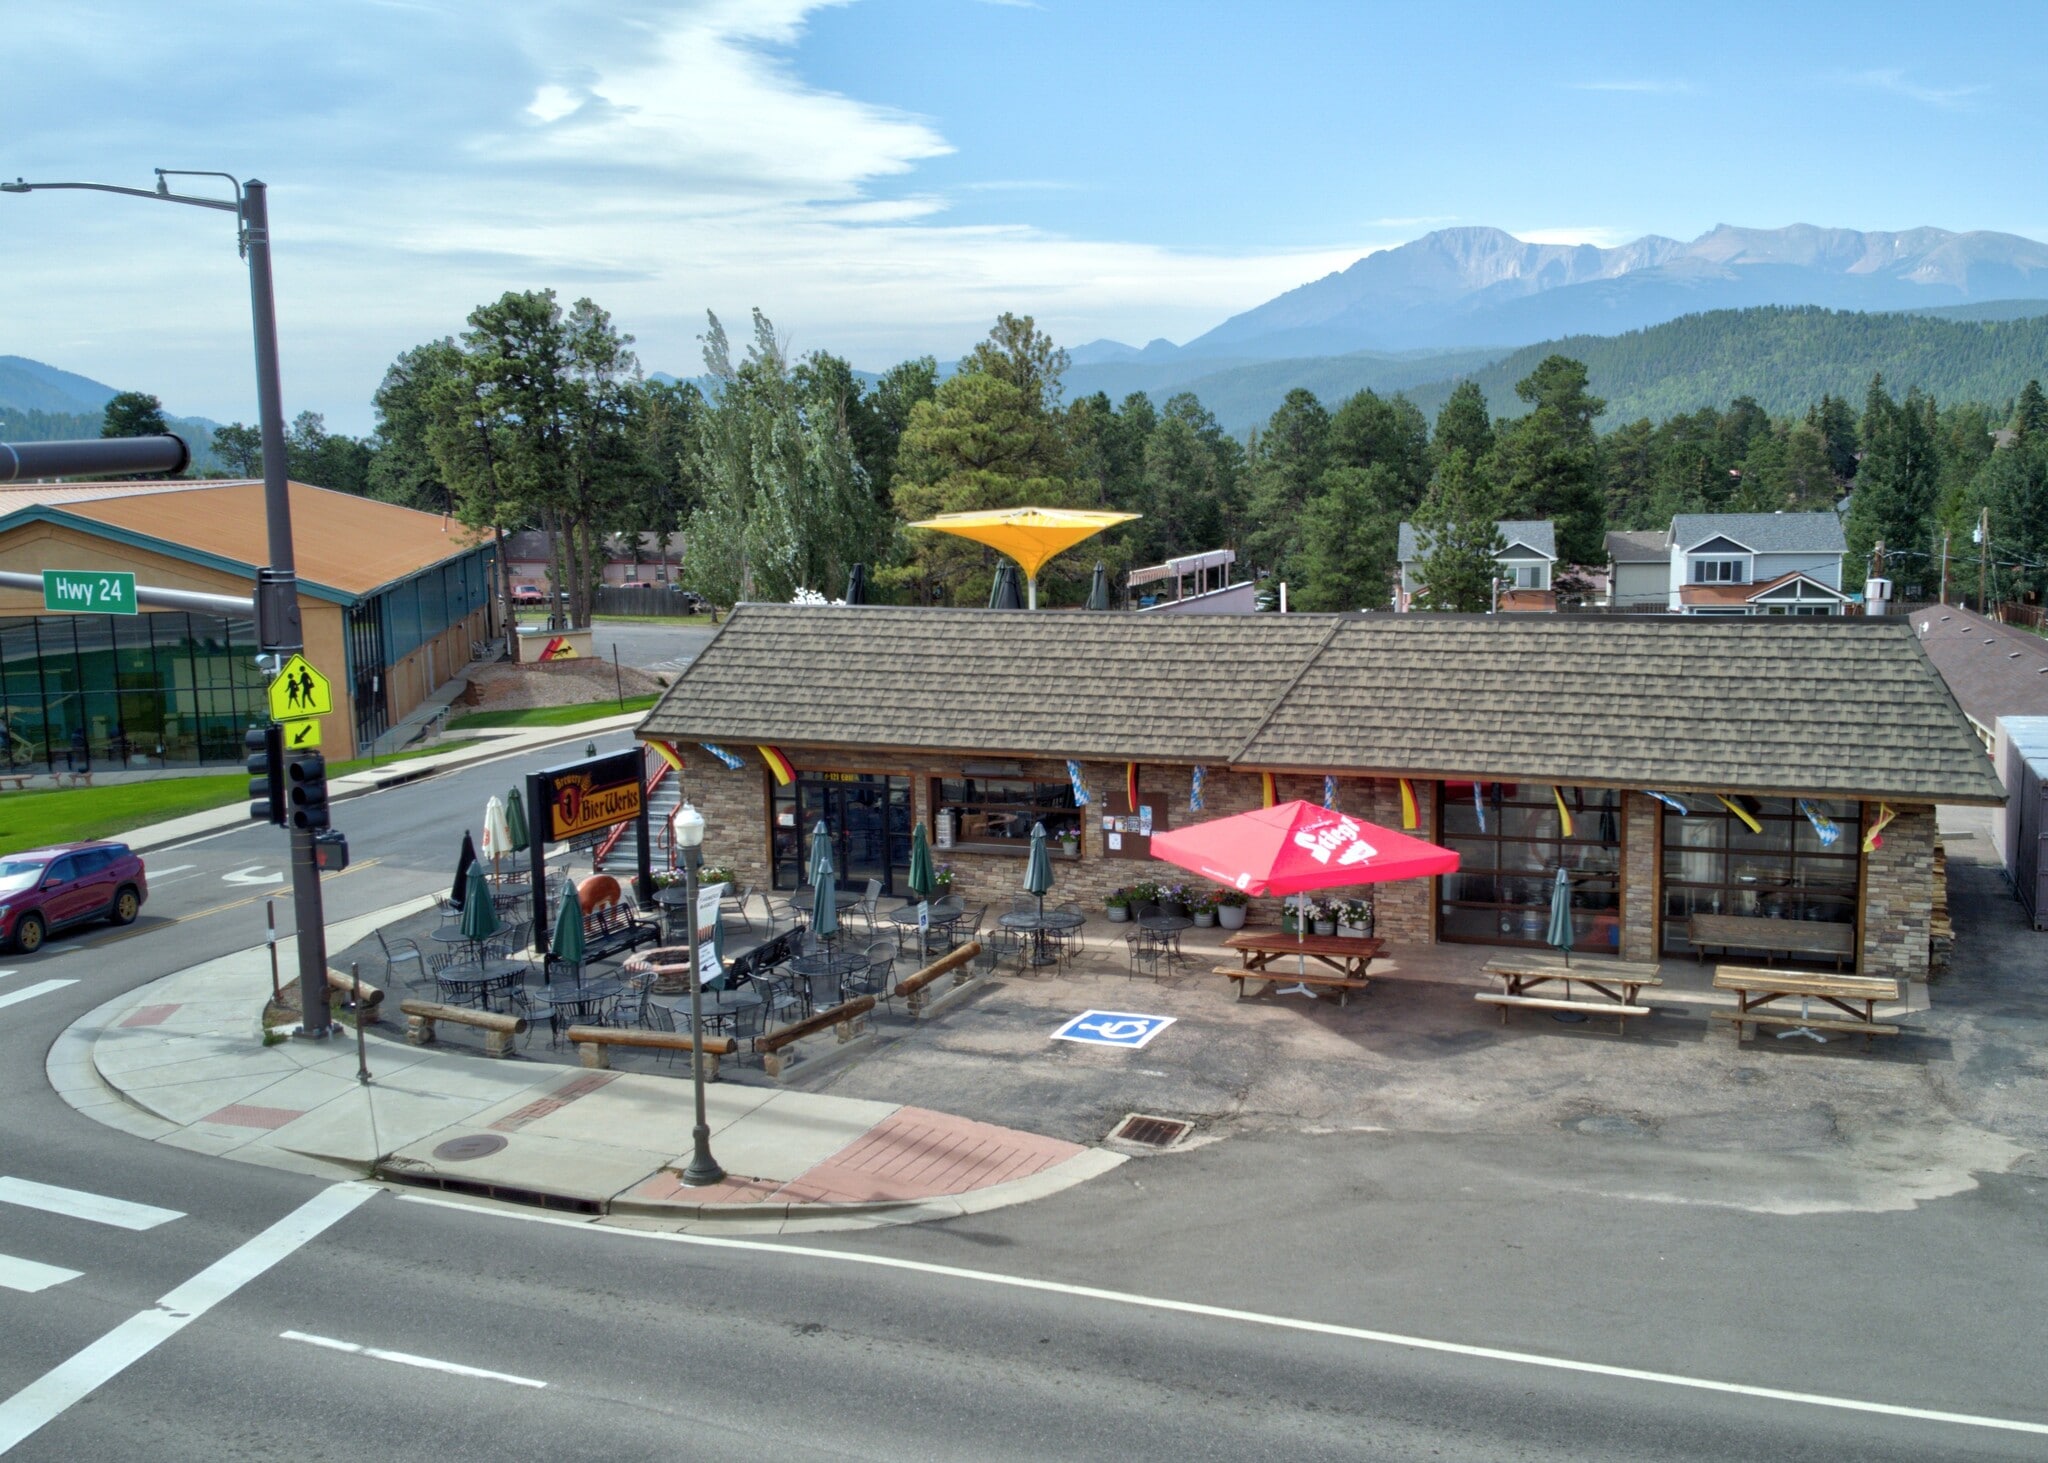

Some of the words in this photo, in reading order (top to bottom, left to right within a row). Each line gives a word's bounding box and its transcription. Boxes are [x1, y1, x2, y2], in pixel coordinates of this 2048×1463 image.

[56, 577, 93, 606] Hwy
[99, 578, 122, 602] 24
[582, 790, 639, 822] BierWerks
[1294, 815, 1361, 865] Stiegl
